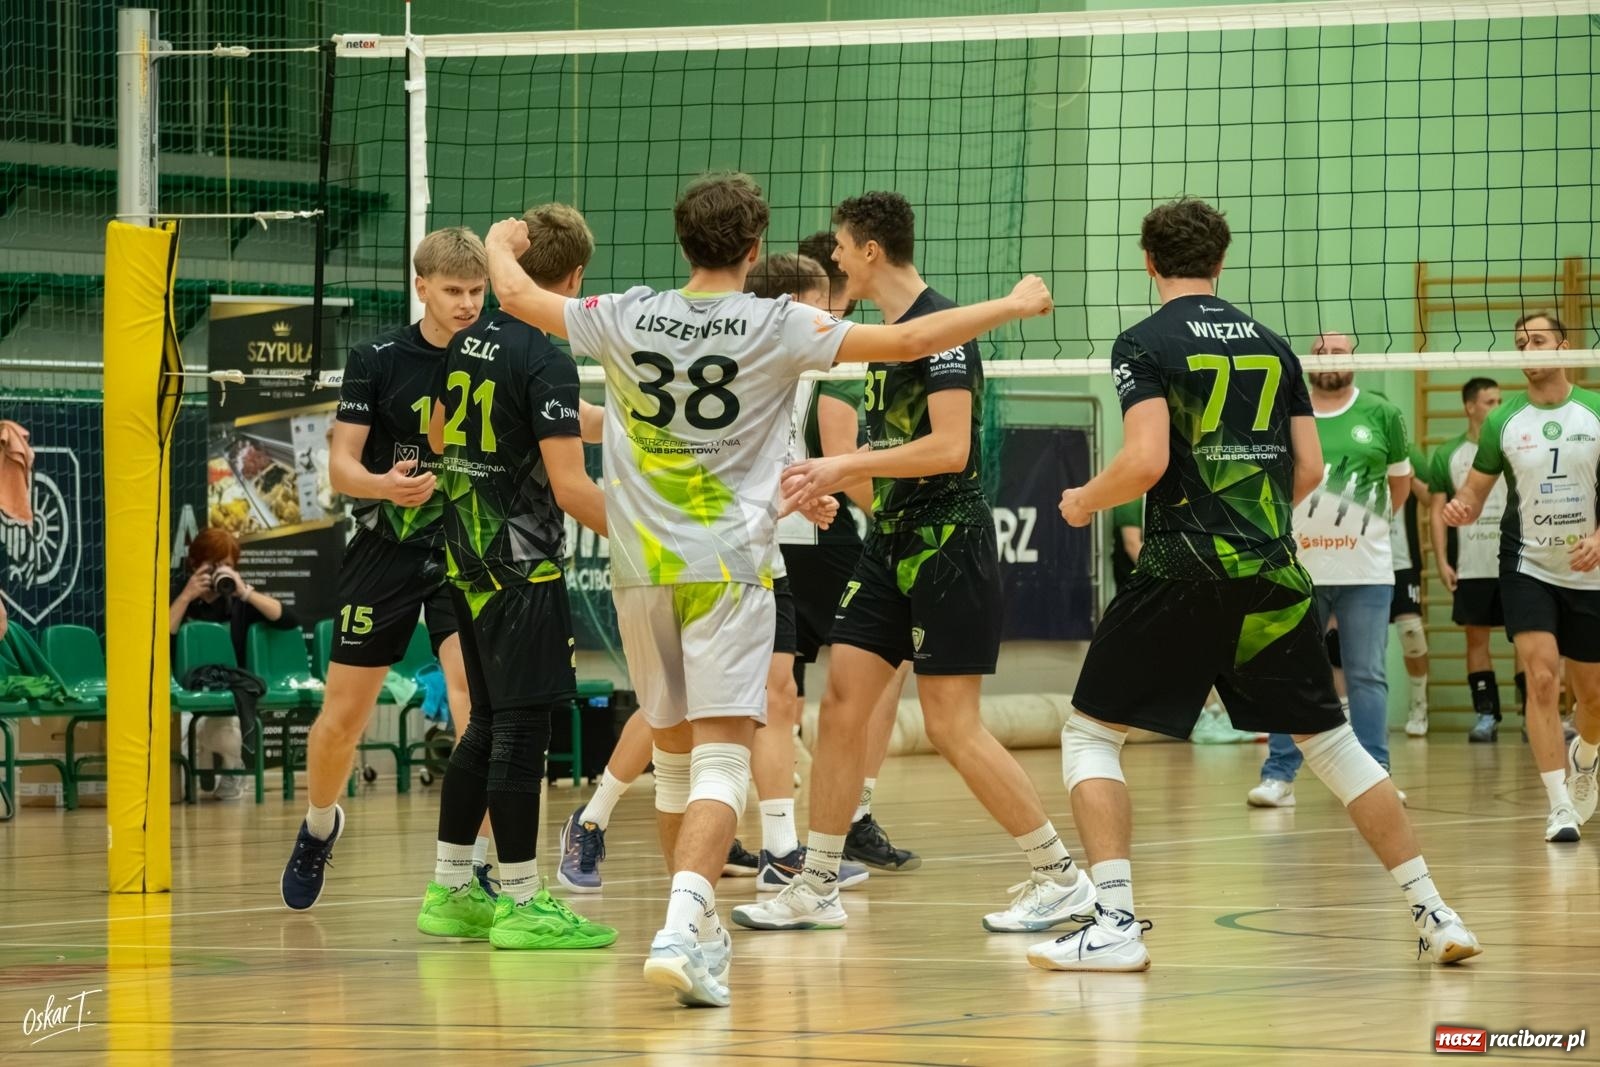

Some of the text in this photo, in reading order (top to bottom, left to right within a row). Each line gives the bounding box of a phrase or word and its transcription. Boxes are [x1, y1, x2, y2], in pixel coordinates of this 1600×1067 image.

[346, 40, 375, 49] netex
[1186, 321, 1260, 344] WIĘZIK
[631, 351, 740, 430] 38
[865, 370, 887, 411] 37
[1186, 354, 1282, 432] 77
[443, 371, 497, 453] 21
[664, 447, 720, 455] SPORTOWY
[1548, 448, 1561, 475] 1
[1312, 535, 1358, 550] sipply
[341, 604, 374, 635] 15
